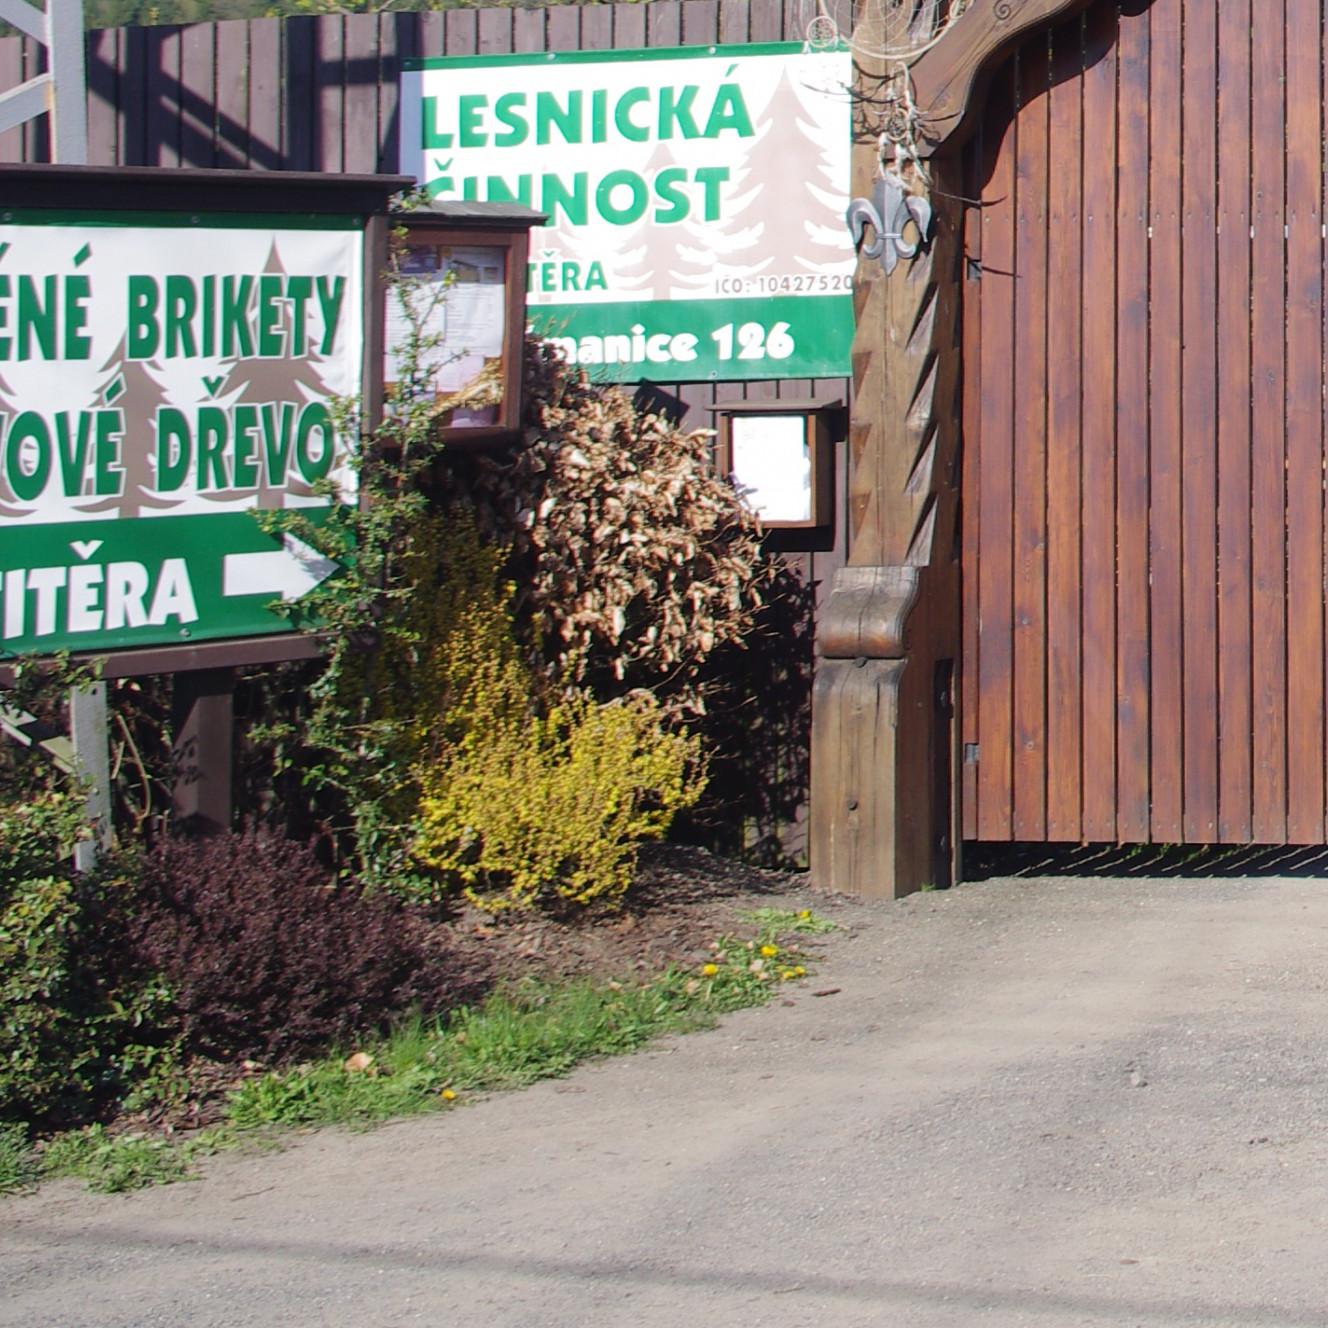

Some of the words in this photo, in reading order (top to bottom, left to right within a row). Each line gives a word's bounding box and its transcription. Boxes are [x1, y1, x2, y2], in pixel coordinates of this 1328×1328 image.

[422, 64, 755, 149] LESNICKÁ
[128, 274, 346, 359] BRIKETY
[759, 274, 854, 292] 10427520
[712, 322, 796, 361] 126
[0, 373, 125, 501] OVÉ
[157, 376, 335, 492] DŘEVO
[0, 540, 199, 640] ITĚRA
